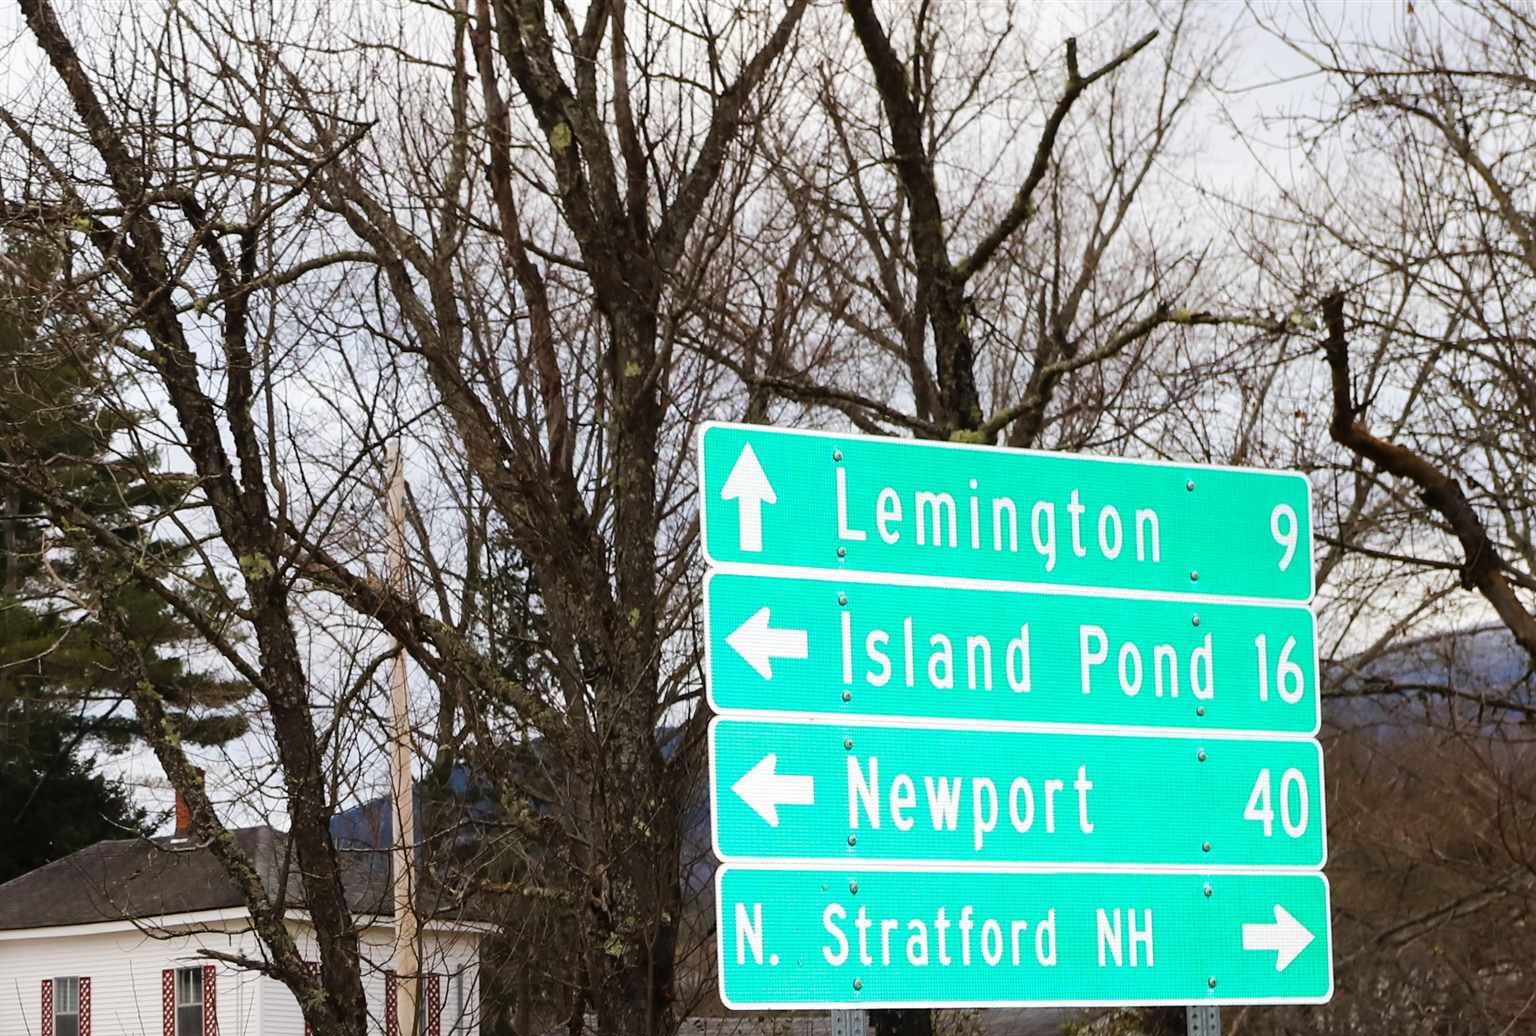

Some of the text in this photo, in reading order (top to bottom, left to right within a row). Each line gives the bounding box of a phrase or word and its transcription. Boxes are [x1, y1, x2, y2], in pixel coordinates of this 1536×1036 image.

[836, 467, 1298, 572] Lemington 9
[841, 612, 1305, 704] Island Pond 16
[847, 756, 1309, 850] Newport 40
[736, 903, 1154, 967] N. Stratford NH
